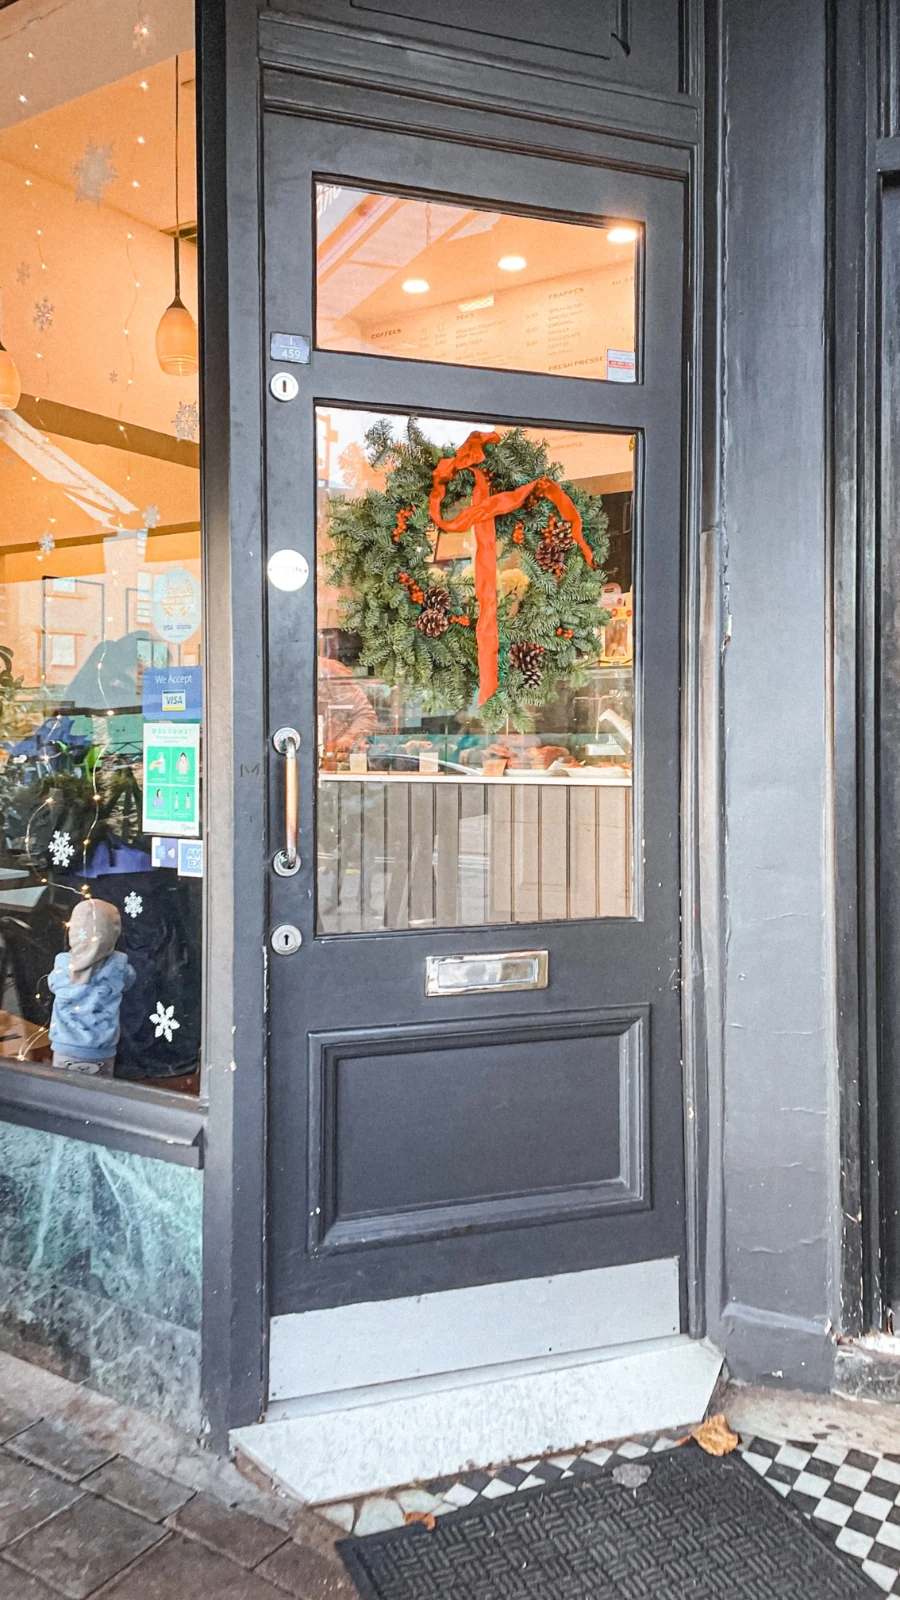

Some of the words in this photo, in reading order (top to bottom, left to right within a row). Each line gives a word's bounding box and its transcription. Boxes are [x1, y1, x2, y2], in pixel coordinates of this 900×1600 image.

[280, 348, 302, 360] 459
[548, 363, 573, 372] FRESH
[155, 674, 167, 685] We
[168, 673, 193, 686] Accept
[165, 695, 184, 705] VISA
